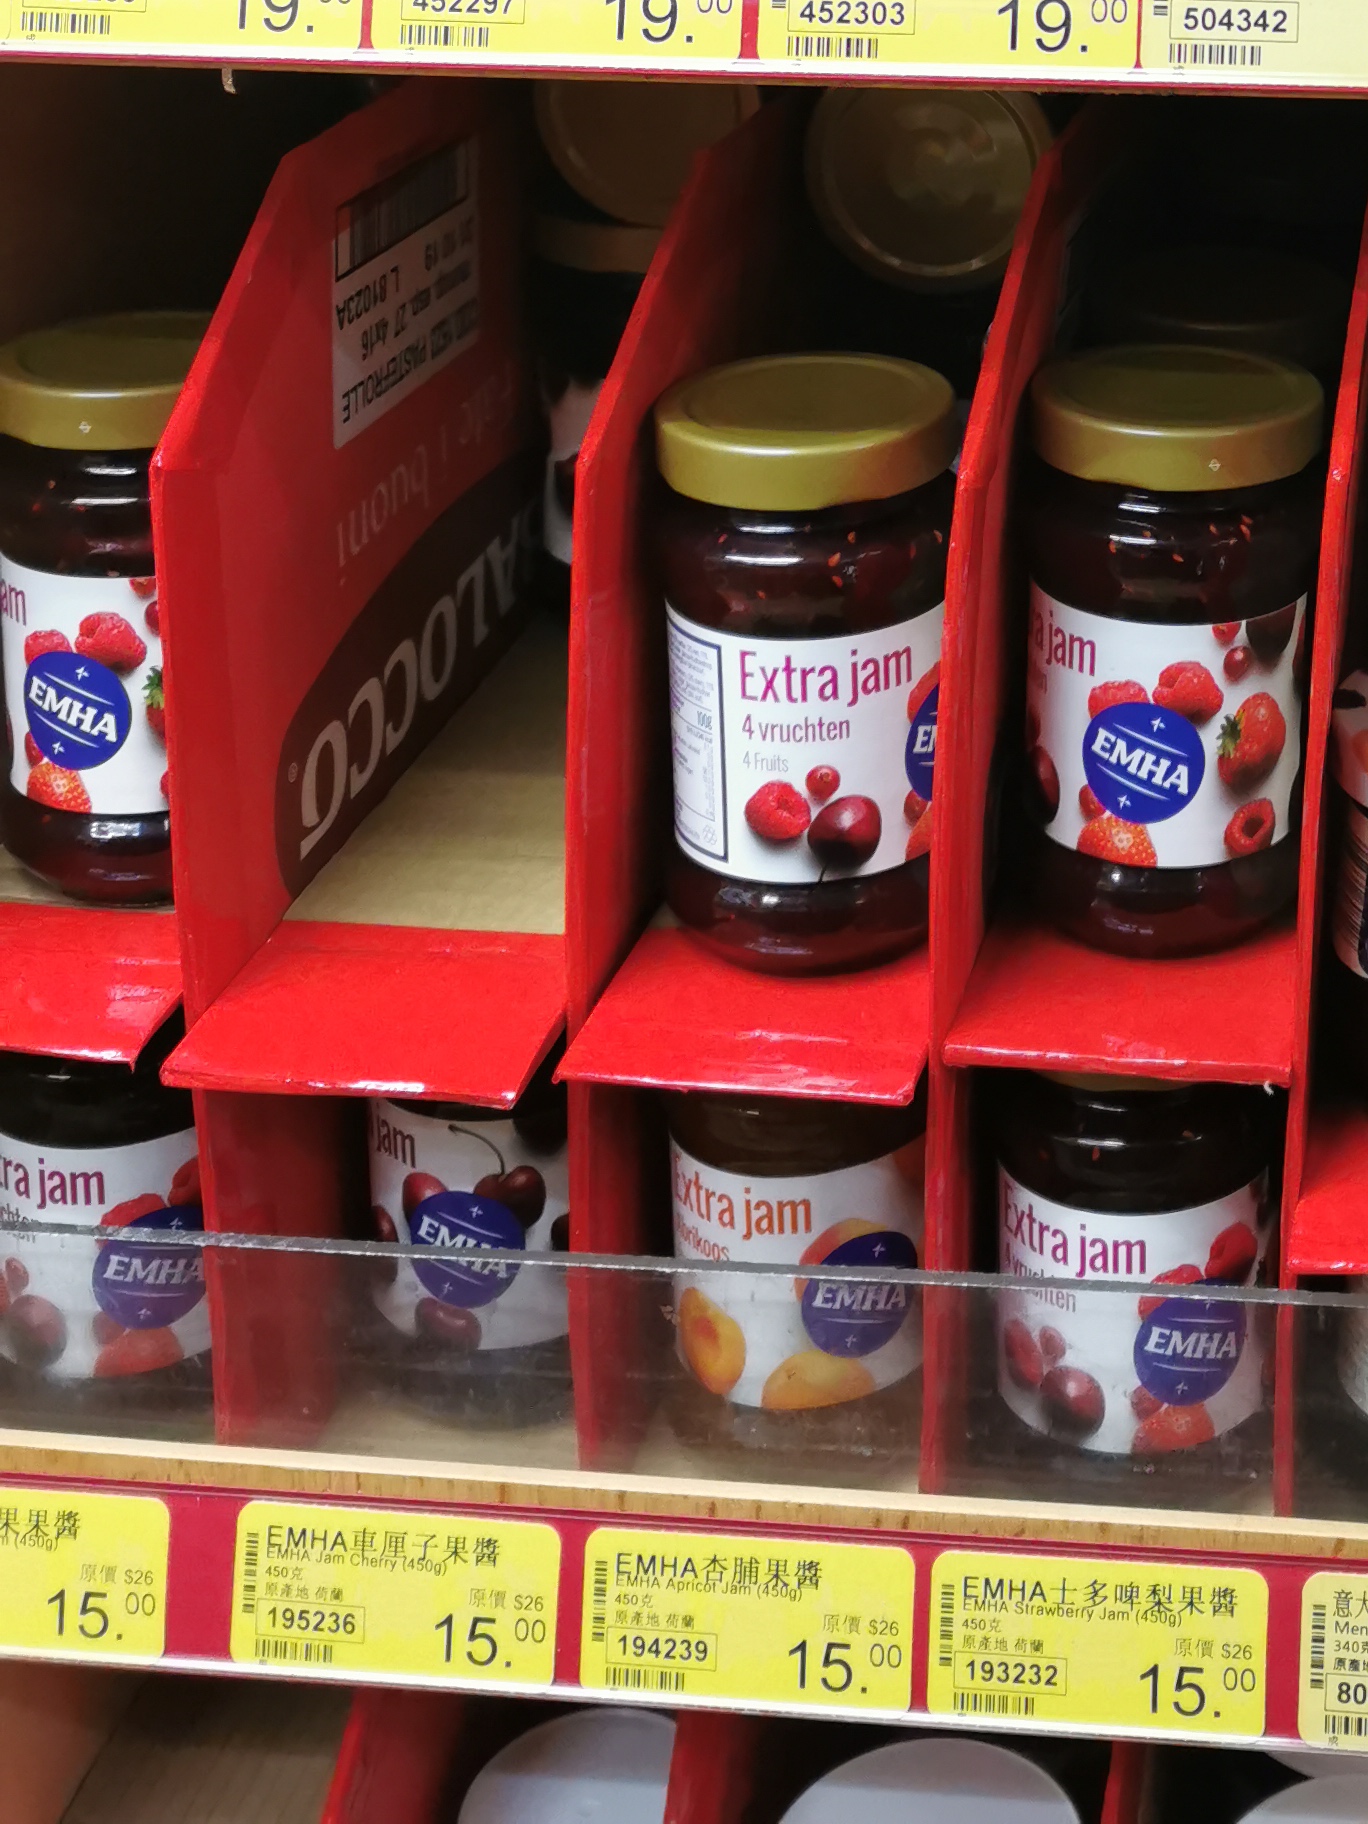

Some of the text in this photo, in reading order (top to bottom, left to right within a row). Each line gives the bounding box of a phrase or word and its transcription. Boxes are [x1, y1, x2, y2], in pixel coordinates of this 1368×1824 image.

[800, 0, 905, 26] 452303
[1184, 8, 1287, 33] 504342
[740, 646, 912, 707] Extra jam
[29, 676, 117, 743] EMHA
[742, 714, 850, 743] 4 vruchten
[1091, 727, 1189, 796] EMHA
[743, 1187, 811, 1240] jam
[1076, 1224, 1146, 1278] jam
[812, 1280, 906, 1310] EMHA
[1144, 1326, 1237, 1359] EMHA
[316, 1552, 397, 1572] Jam Cherry
[666, 1578, 751, 1596] Apricot Jam
[268, 1606, 356, 1634] 195236
[1014, 1602, 1130, 1623] Strawberry Jam
[618, 1635, 708, 1662] 194239
[966, 1660, 1058, 1686] 193232
